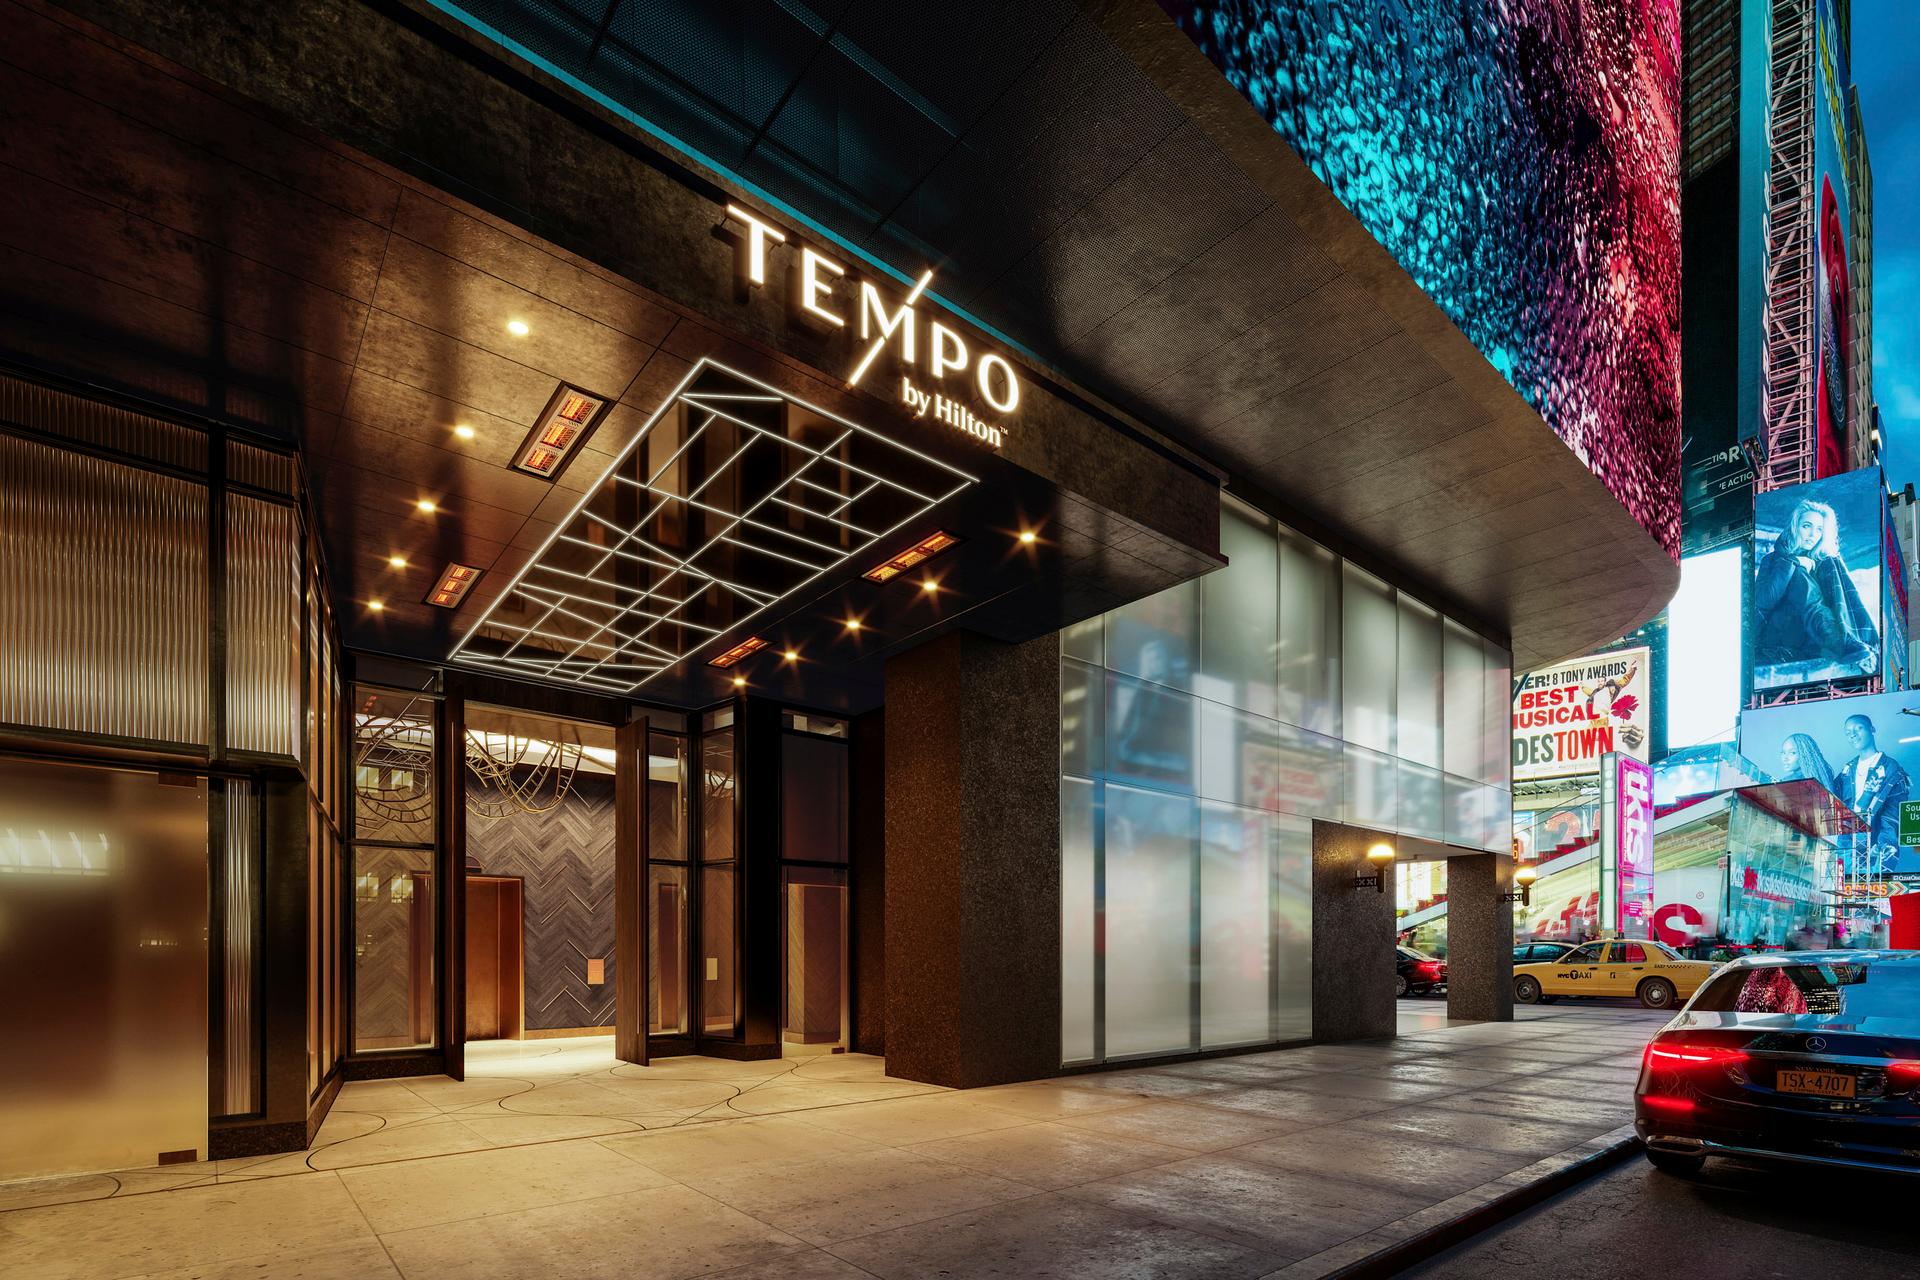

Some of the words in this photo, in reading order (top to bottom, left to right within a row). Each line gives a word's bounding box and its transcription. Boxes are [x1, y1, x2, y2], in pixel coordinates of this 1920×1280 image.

[727, 203, 1021, 414] TEMPO
[902, 376, 931, 418] by
[1514, 674, 1550, 690] ER!
[1552, 673, 1558, 686] 8
[1561, 668, 1585, 684] TONY
[1587, 661, 1627, 680] AWARDS
[1520, 686, 1579, 710] BEST
[1627, 771, 1648, 864] tkts
[1569, 969, 1592, 980] TAXI
